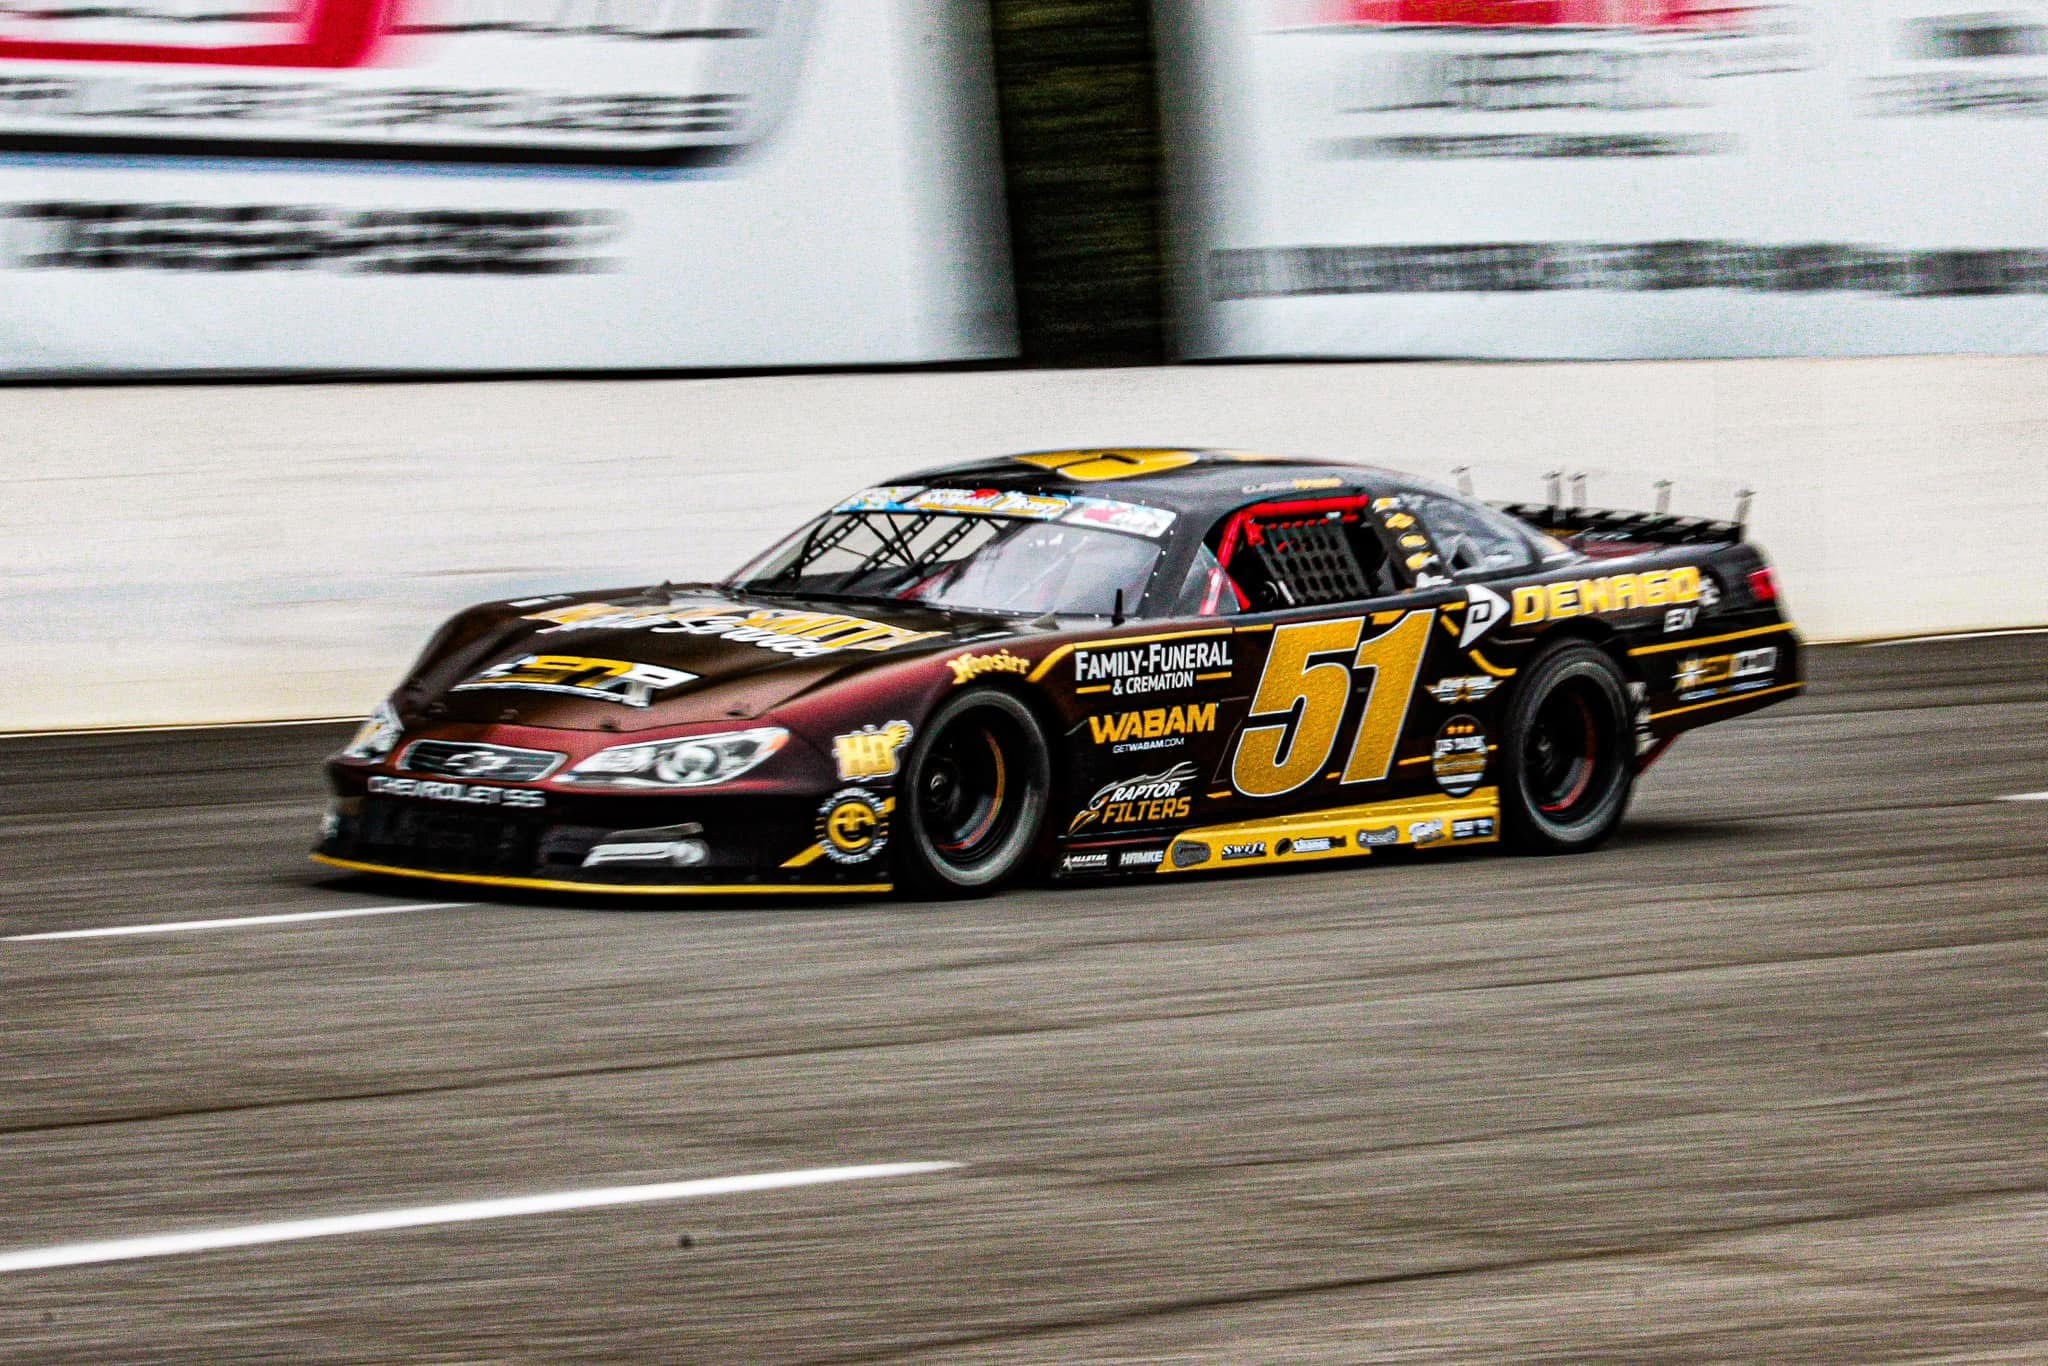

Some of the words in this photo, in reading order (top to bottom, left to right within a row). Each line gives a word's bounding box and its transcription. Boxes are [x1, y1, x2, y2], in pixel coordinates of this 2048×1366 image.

[1075, 640, 1233, 681] FAMILY-FUNERAL
[1112, 679, 1124, 696] &
[1126, 670, 1194, 694] CREMATION
[1232, 608, 1437, 798] 51
[1089, 703, 1217, 744] WABAM
[1112, 737, 1185, 754] GETWABAM.COM
[1110, 781, 1181, 802] RAPTOR
[1102, 796, 1192, 824] FILTERS
[1222, 841, 1266, 856] Swift
